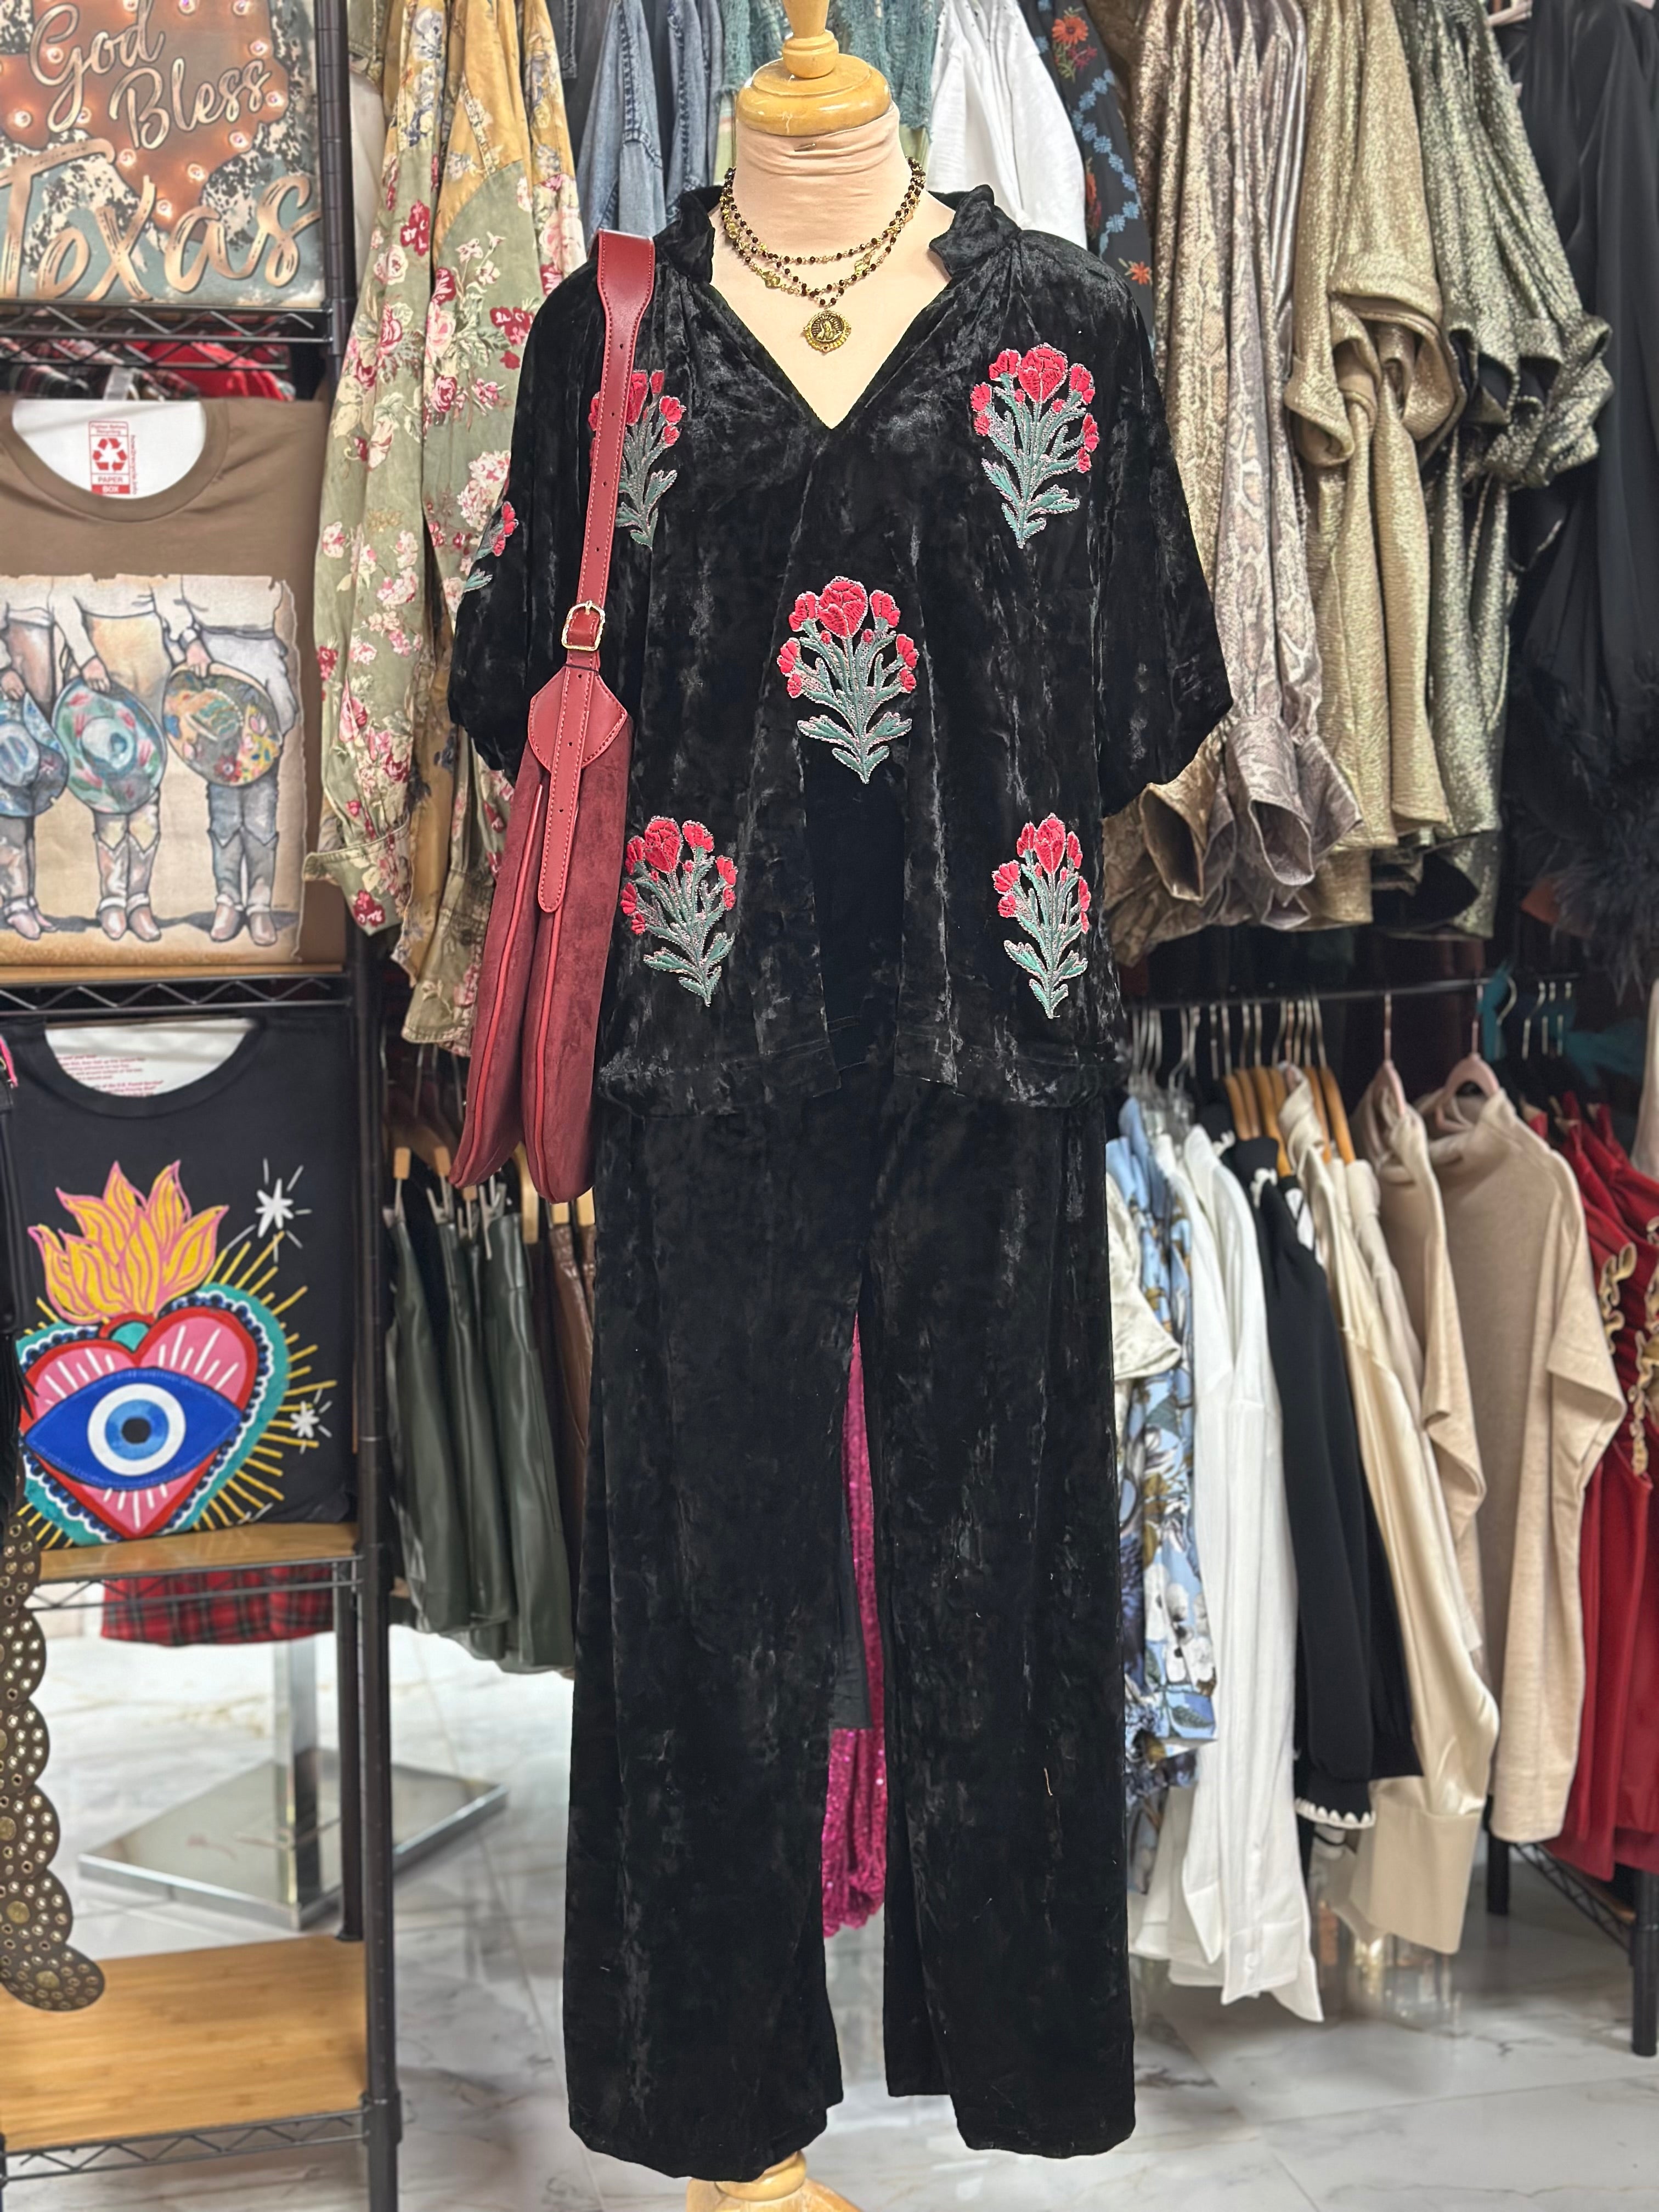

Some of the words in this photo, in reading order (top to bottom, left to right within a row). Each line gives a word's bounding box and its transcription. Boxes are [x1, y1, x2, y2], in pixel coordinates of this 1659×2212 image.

[30, 0, 165, 132] God
[109, 58, 272, 150] Bless
[0, 138, 323, 301] Texas
